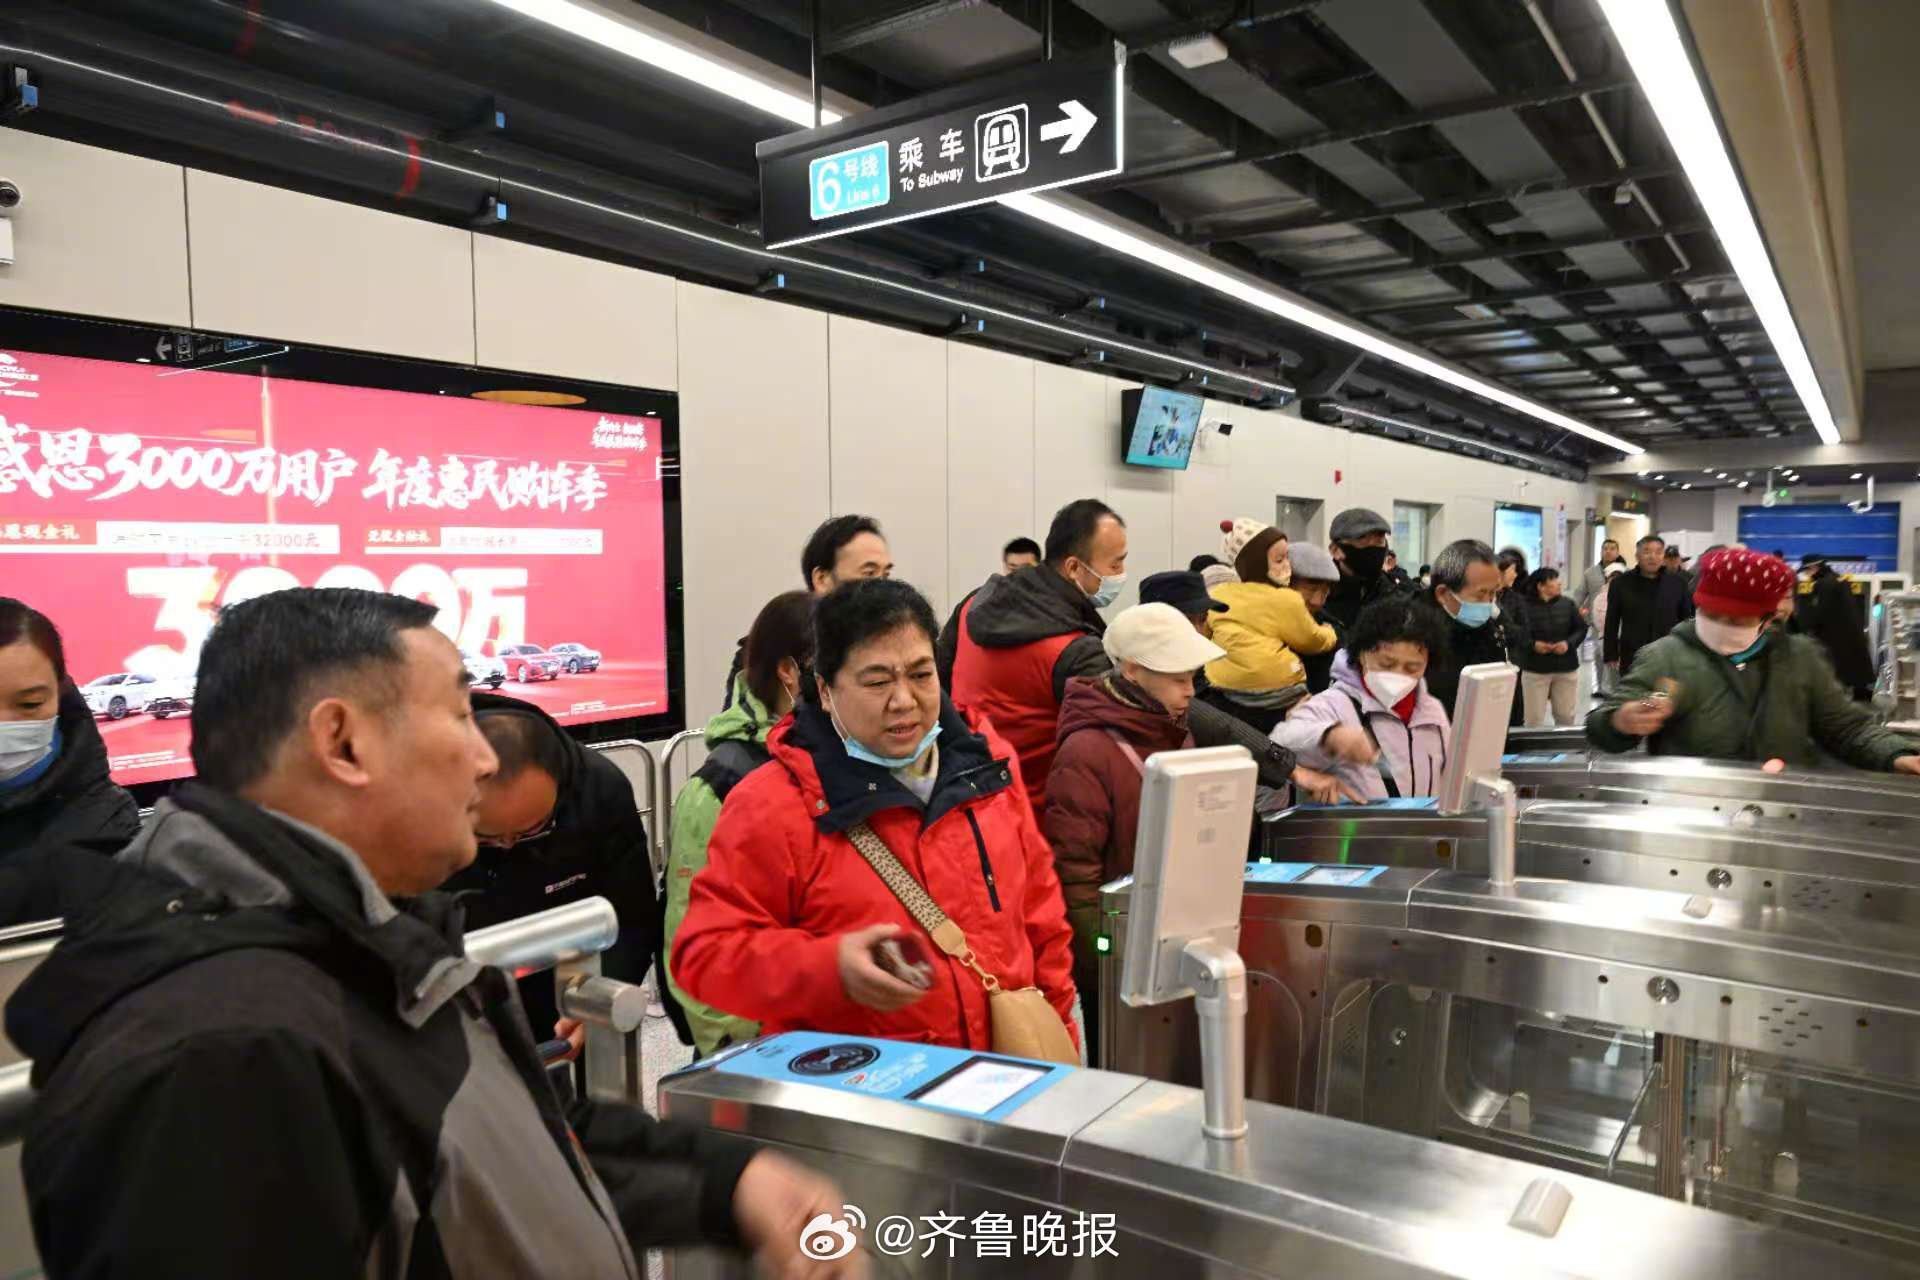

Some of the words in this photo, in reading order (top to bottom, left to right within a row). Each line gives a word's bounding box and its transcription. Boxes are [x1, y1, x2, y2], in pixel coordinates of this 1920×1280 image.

[899, 128, 965, 173] 乘车
[817, 161, 841, 211] 6
[844, 153, 879, 184] 号线
[900, 177, 915, 192] To
[918, 168, 964, 188] Subway
[0, 415, 359, 507] 感恩3000万用户
[361, 447, 608, 513] 年度惠民购车季
[0, 523, 80, 541] 恩现金礼
[122, 564, 528, 677] 30万
